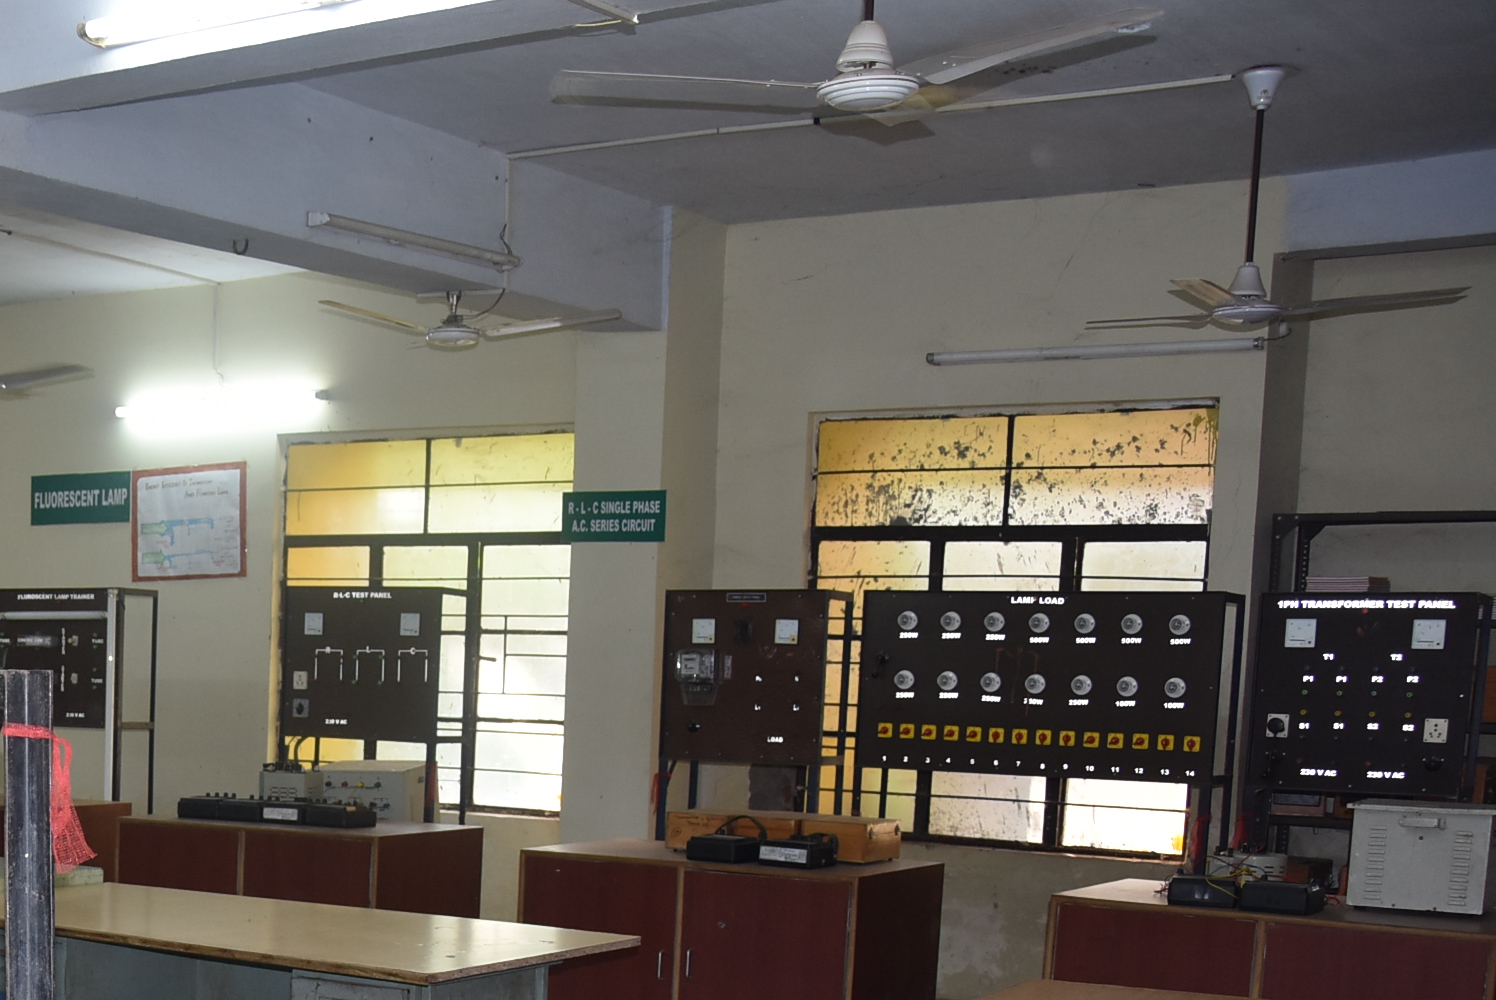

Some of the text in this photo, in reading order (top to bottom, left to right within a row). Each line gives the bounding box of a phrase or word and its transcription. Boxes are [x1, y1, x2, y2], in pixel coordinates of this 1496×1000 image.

[34, 488, 128, 509] FLUORESCENT LAMP
[600, 501, 631, 514] SINGLE
[632, 501, 660, 513] PHASE
[571, 519, 656, 532] A.C. SERIES CIRCUIT
[1039, 597, 1065, 605] LOAD
[1277, 600, 1456, 609] 1PH TRANSFORMER TEST PANEL
[1323, 653, 1335, 661] T1
[1390, 653, 1403, 661] T2
[1303, 675, 1314, 683] P1
[1336, 675, 1348, 683] P1
[1324, 769, 1337, 777] AC
